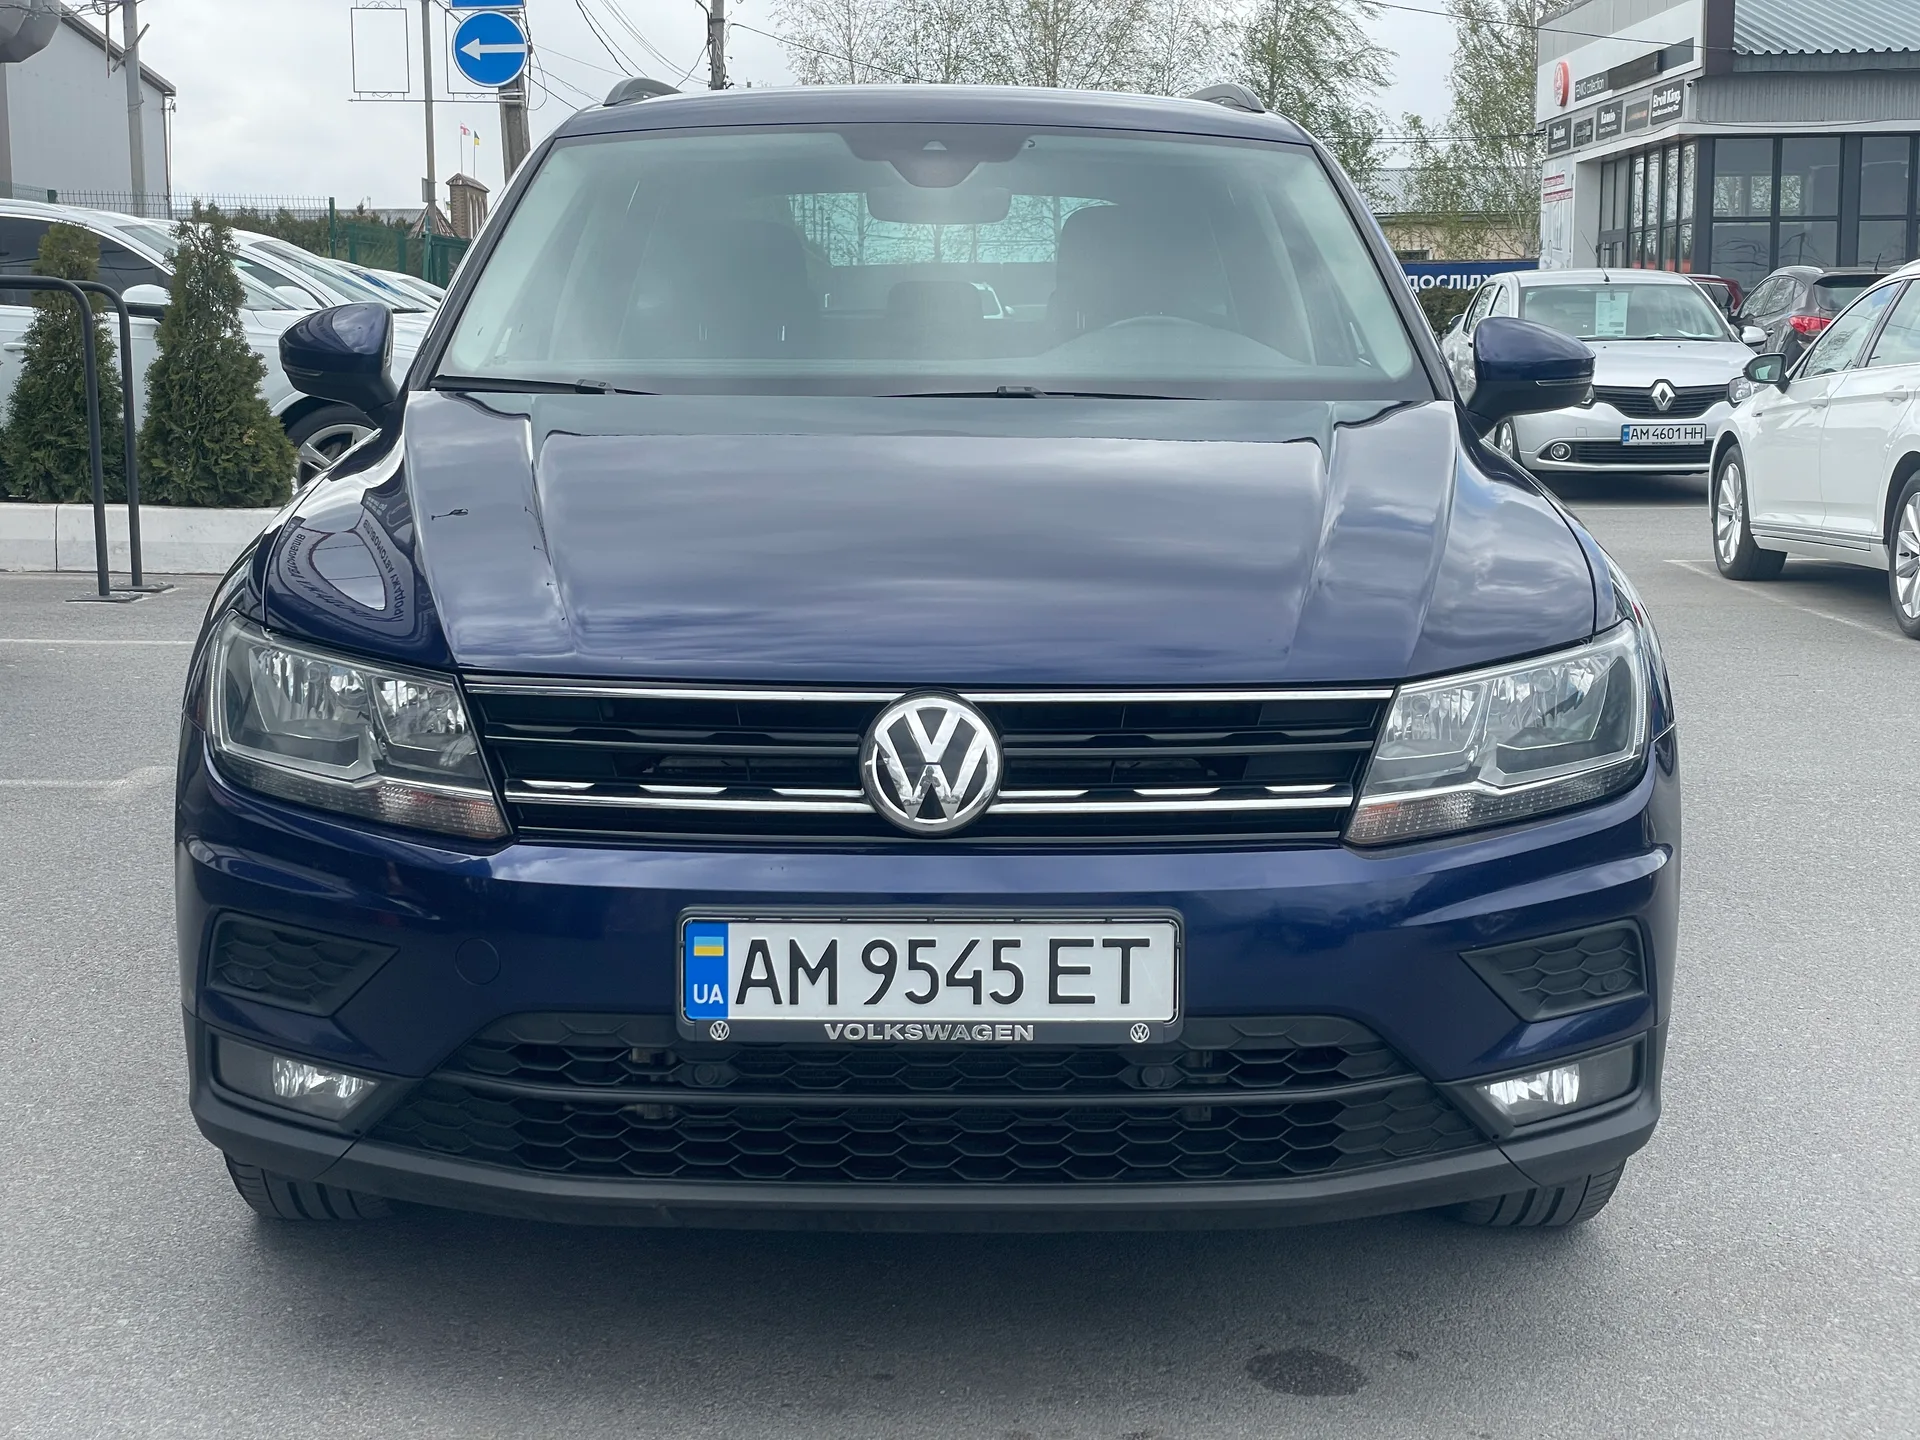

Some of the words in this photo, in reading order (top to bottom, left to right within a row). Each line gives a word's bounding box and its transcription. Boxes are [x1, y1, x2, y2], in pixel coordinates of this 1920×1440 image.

[1407, 274, 1494, 293] ДОСЛІД
[1630, 427, 1650, 440] AM
[1652, 427, 1681, 440] 4601
[1684, 426, 1703, 440] HH
[735, 938, 839, 1005] AM
[860, 938, 1025, 1005] 9545
[1048, 937, 1151, 1005] ET
[692, 984, 723, 1004] UA
[823, 1022, 1034, 1041] VOLKSWAGEN
